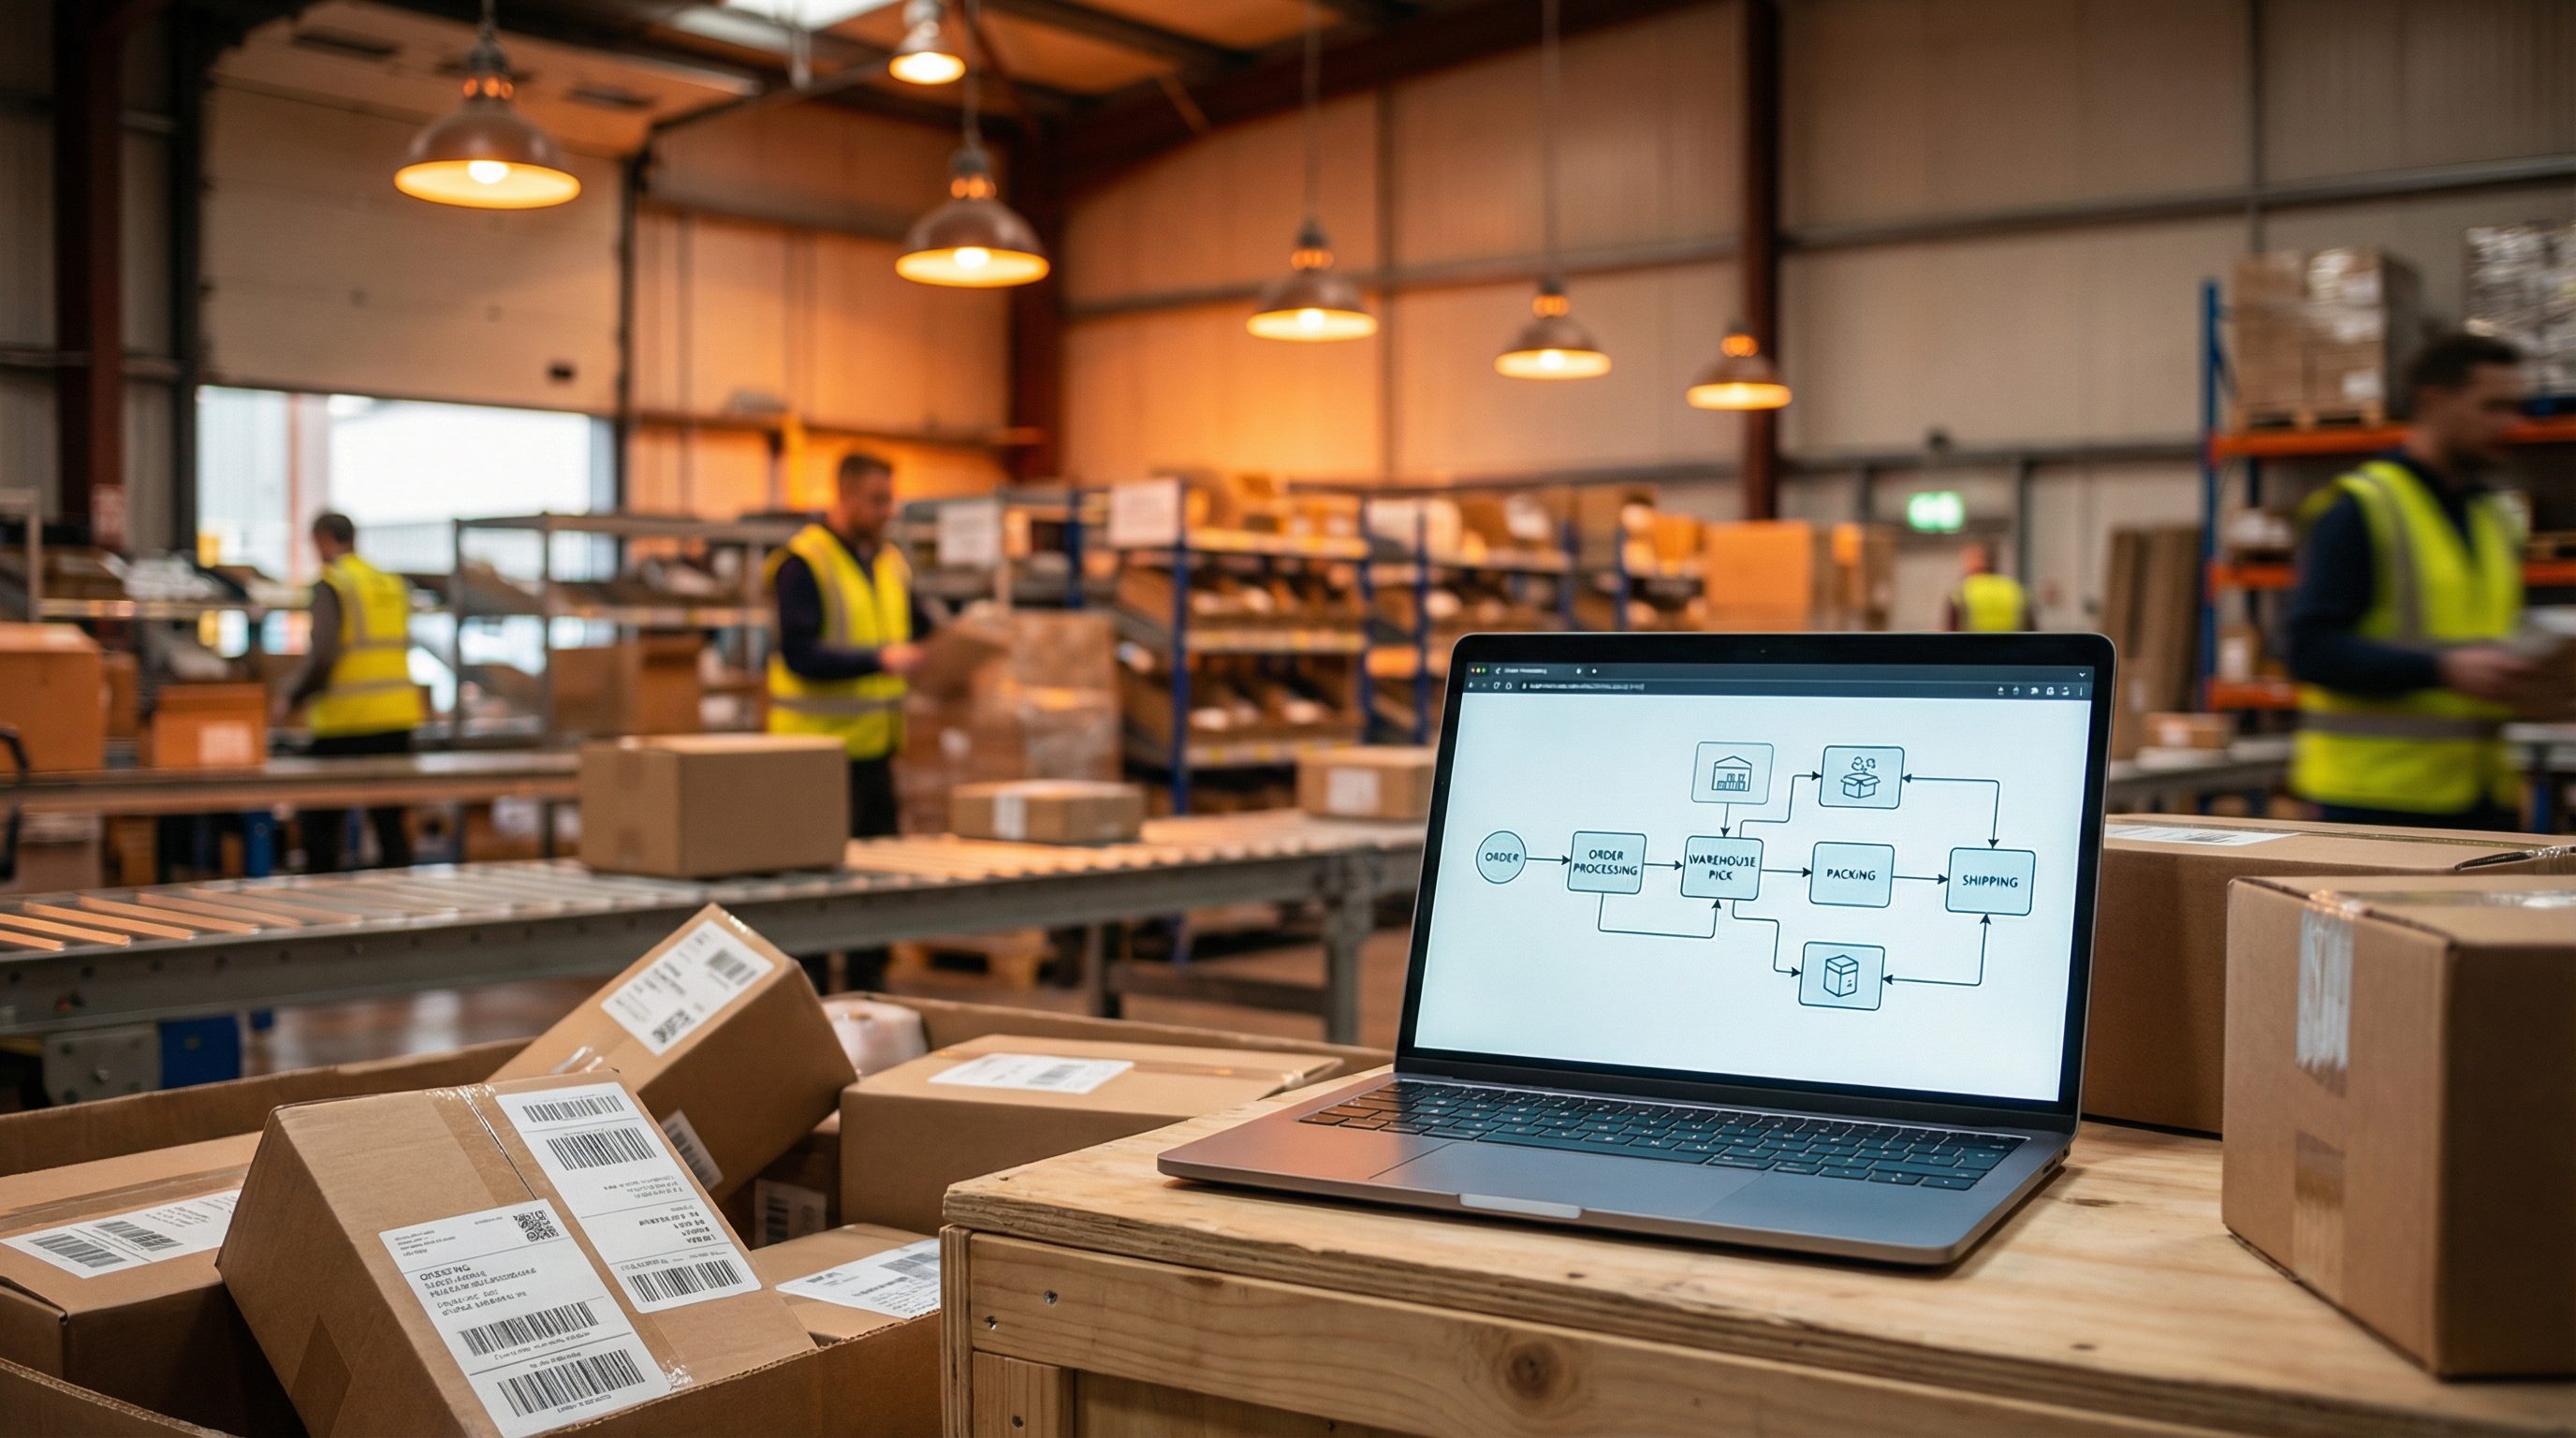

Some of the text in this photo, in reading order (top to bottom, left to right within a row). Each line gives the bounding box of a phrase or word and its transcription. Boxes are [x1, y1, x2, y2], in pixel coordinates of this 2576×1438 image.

[1486, 852, 1519, 863] ORDER
[1588, 849, 1624, 860] ORDER
[1573, 863, 1638, 876] PROCESSING
[1826, 869, 1876, 881] PACKING
[1708, 870, 1733, 881] PICK
[1962, 874, 2018, 888] SHIPPING
